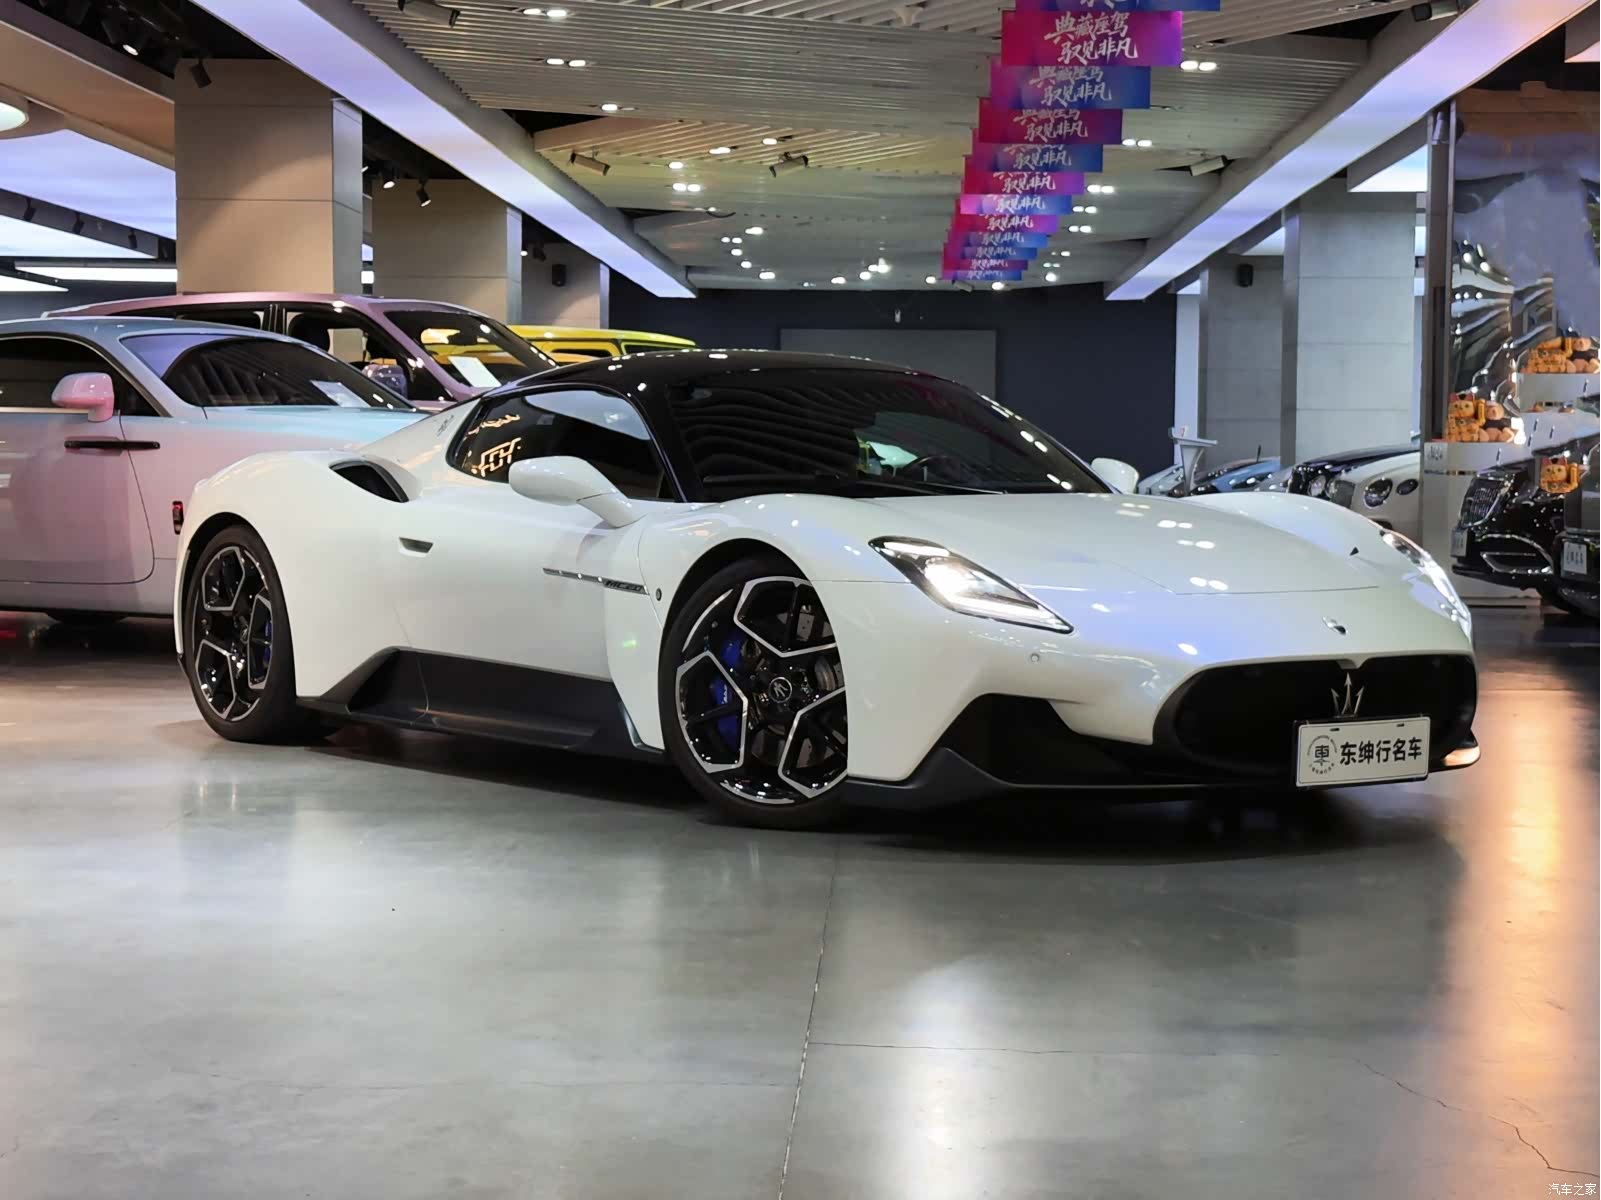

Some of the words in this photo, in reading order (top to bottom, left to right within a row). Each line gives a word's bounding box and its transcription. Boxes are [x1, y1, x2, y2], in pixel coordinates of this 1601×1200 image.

[1043, 11, 1130, 45] 典藏座驾
[1057, 37, 1138, 65] 驭见非凡
[1041, 82, 1112, 107] 驭见非凡
[1024, 121, 1088, 143] 驭见非凡
[1013, 150, 1072, 170] 驭见非凡
[1002, 174, 1056, 194] 驭见非凡
[1340, 737, 1422, 765] 东绅行名车
